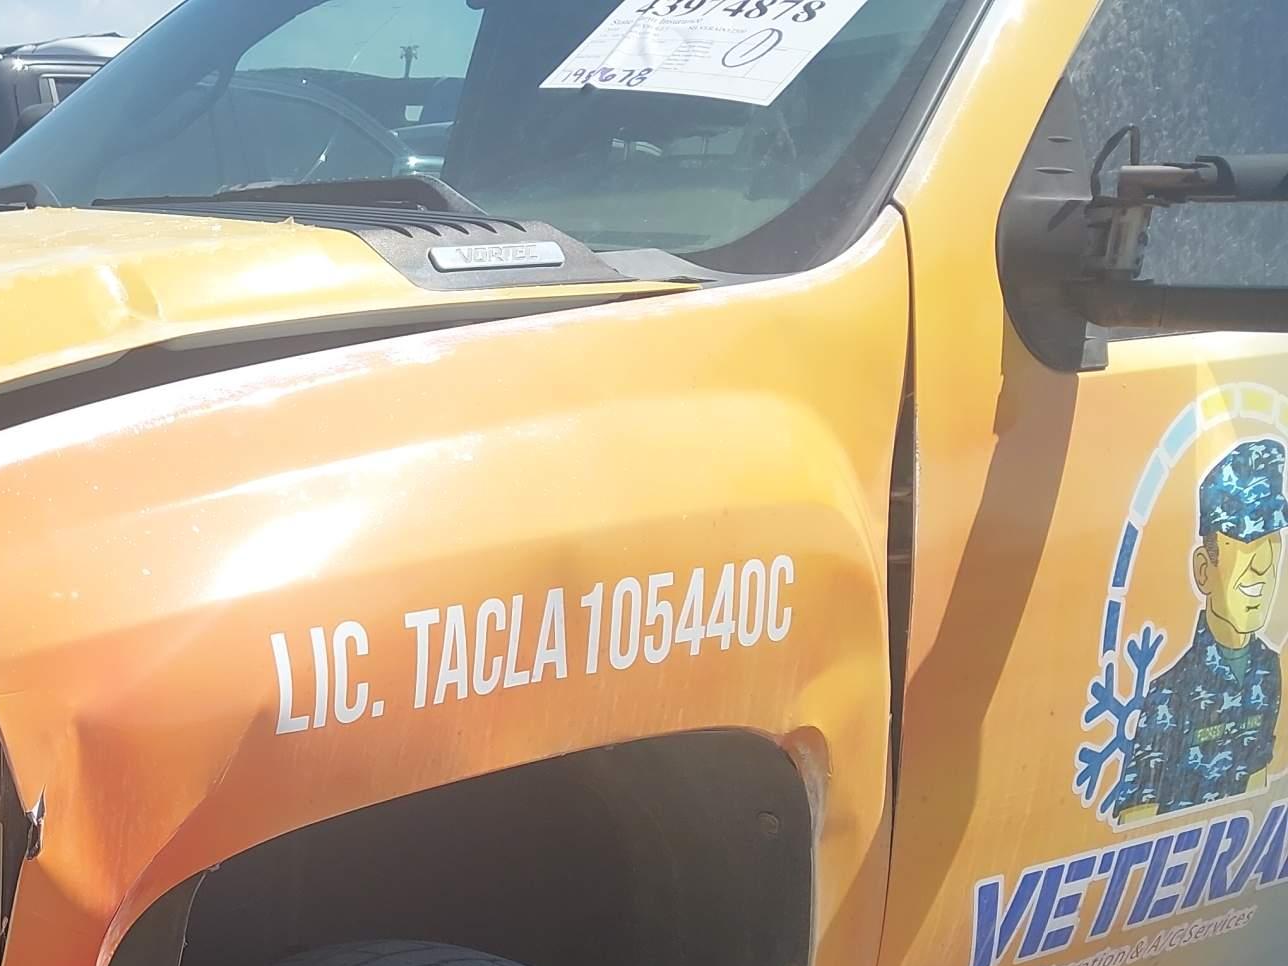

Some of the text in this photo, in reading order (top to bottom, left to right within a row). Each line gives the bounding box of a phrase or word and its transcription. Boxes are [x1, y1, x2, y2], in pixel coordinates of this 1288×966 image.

[270, 554, 795, 736] LIC. TACLA 105440C
[1129, 939, 1145, 959] &
[1182, 907, 1256, 944] Services
